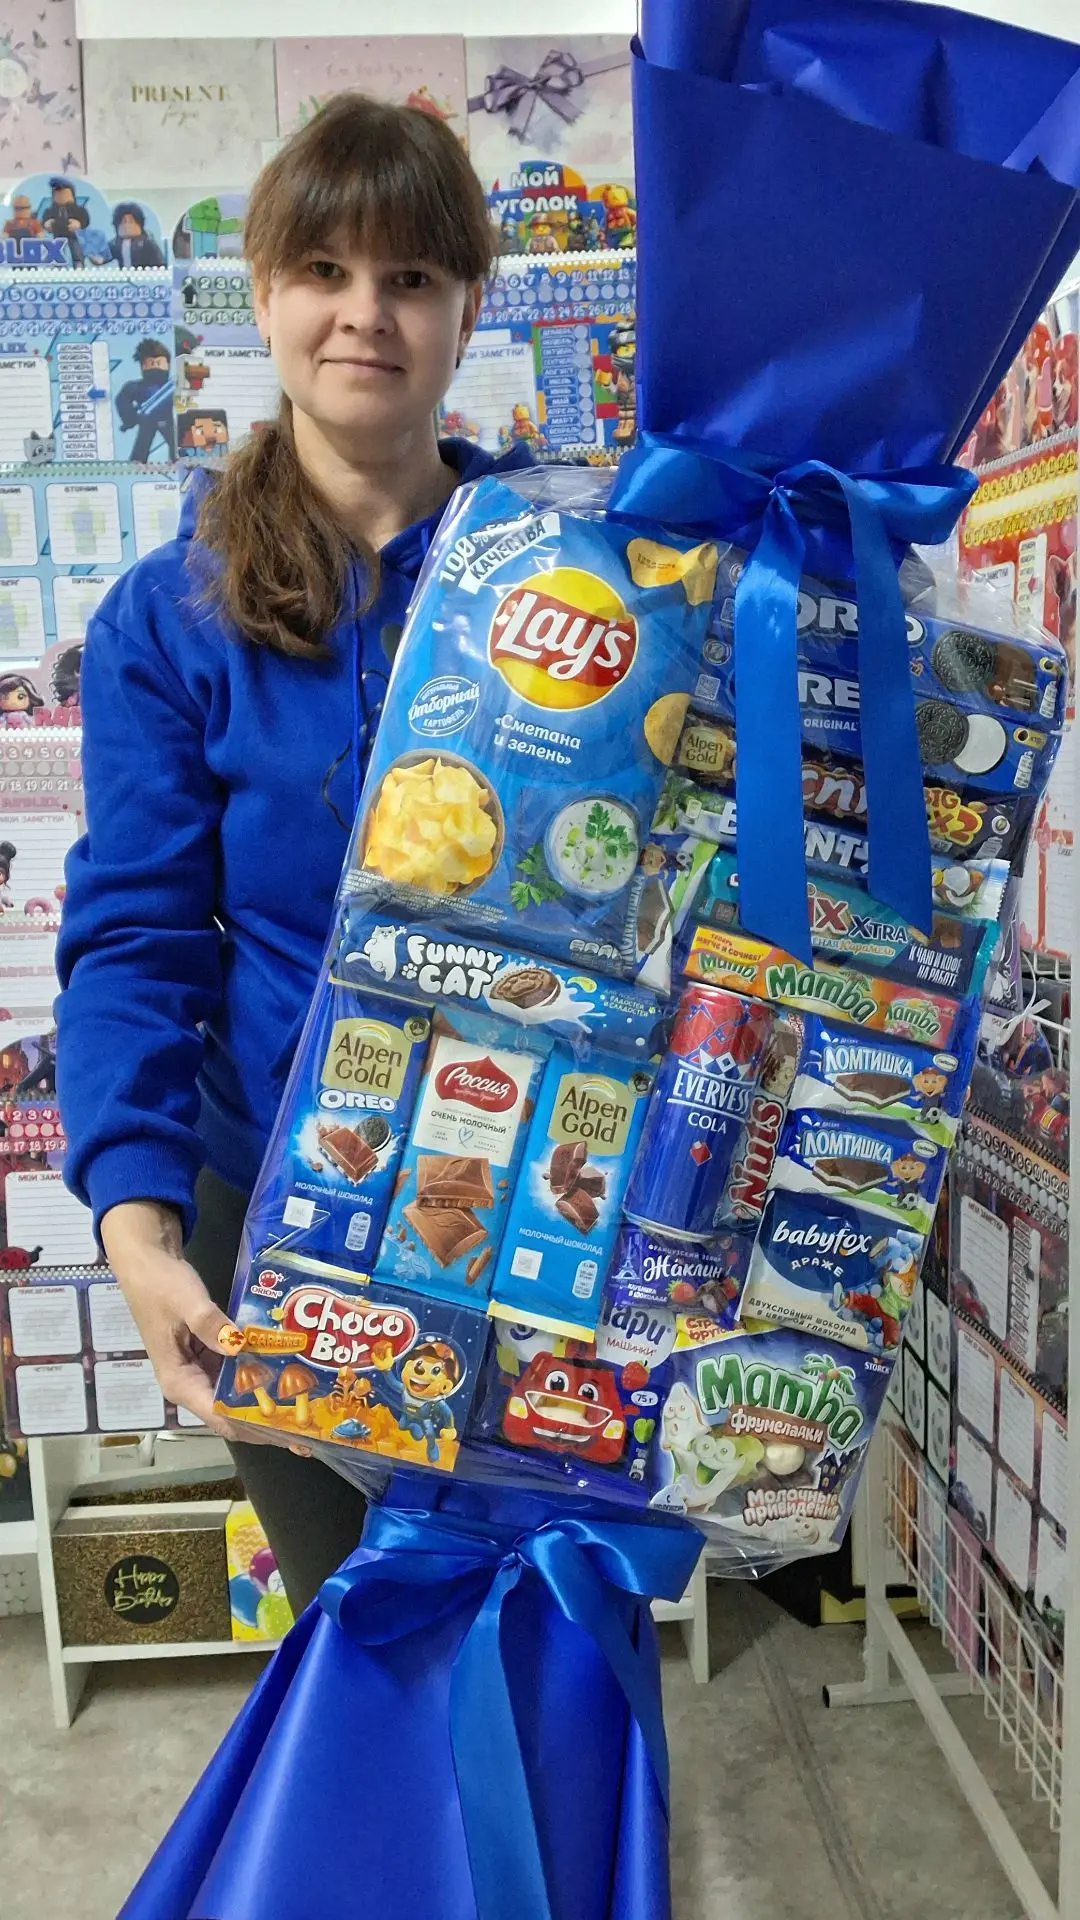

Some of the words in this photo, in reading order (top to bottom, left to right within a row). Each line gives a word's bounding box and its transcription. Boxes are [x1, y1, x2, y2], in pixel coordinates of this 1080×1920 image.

[132, 85, 225, 102] PRESENT
[511, 165, 559, 187] МОЙ
[496, 195, 577, 214] УГОЛОК
[201, 277, 211, 289] 2
[216, 277, 226, 289] 3
[232, 277, 242, 289] 4
[495, 276, 504, 287] 5
[510, 275, 519, 286] 6
[525, 274, 535, 286] 7
[557, 272, 566, 283] 9
[572, 271, 583, 282] 10
[588, 270, 598, 281] 11
[602, 269, 614, 280] 12
[618, 268, 629, 280] 13
[10, 289, 21, 300] 5
[26, 289, 36, 300] 6
[43, 288, 53, 299] 7
[58, 288, 68, 299] 8
[75, 288, 85, 299] 9
[90, 287, 102, 298] 10
[107, 287, 118, 298] 11
[122, 287, 133, 298] 12
[138, 287, 149, 298] 13
[153, 286, 166, 298] 14
[185, 311, 197, 324] 16
[201, 311, 214, 324] 17
[217, 311, 229, 324] 18
[233, 311, 244, 324] 19
[480, 348, 525, 359] ЗАМЕТКИ
[470, 518, 547, 580] КАЧЕСТВА
[495, 592, 630, 679] Lay's
[408, 681, 480, 720] Отборный
[423, 706, 465, 728] КАРТОФЕЛЬ
[804, 717, 857, 732] ORIGINAL
[494, 714, 582, 750] «Сметана
[687, 733, 723, 752] Alpen
[8, 747, 18, 759] 3
[24, 747, 33, 758] 4
[40, 747, 50, 758] 5
[55, 747, 65, 758] 6
[71, 747, 81, 757] 7
[494, 733, 505, 747] и
[508, 737, 572, 766] зелень»
[686, 748, 718, 765] Gold
[10, 781, 21, 791] 18
[26, 781, 37, 792] 19
[41, 781, 53, 791] 20
[57, 781, 68, 791] 21
[850, 915, 909, 944] XTRA
[406, 935, 502, 972] FUNNY
[908, 945, 916, 961] К
[916, 947, 932, 967] ЧАЮ
[933, 951, 941, 967] И
[941, 954, 963, 973] КОФЕ
[418, 963, 492, 999] CAT
[916, 964, 928, 979] НА
[928, 966, 959, 987] РАБОТЕ
[766, 964, 877, 1023] Mamba
[334, 1032, 402, 1067] Alpen
[335, 1058, 392, 1089] Gold
[825, 1047, 914, 1078] ЛОМТИШКА
[444, 1066, 510, 1100] Россия
[673, 1068, 752, 1114] EVERVESS
[320, 1090, 396, 1112] OREO
[560, 1089, 628, 1122] Alpen
[12, 1110, 23, 1121] 2
[28, 1110, 37, 1120] 3
[42, 1109, 52, 1119] 4
[431, 1110, 457, 1122] ОЧЕНЬ
[460, 1116, 507, 1134] МОЛОЧНЫЙ
[687, 1112, 728, 1134] COLA
[561, 1112, 617, 1143] Gold
[14, 1141, 25, 1151] 17
[30, 1141, 41, 1151] 18
[45, 1140, 56, 1151] 19
[805, 1131, 893, 1163] ЛОМТИШКА
[295, 1181, 336, 1196] МОЛОЧНЫЙ
[337, 1190, 373, 1205] ШОКОЛАД
[519, 1227, 564, 1244] МОЛОЧНЫЙ
[564, 1239, 603, 1256] ШОКОЛАД
[772, 1220, 872, 1256] babyfox
[791, 1257, 844, 1278] ДРАЖЕ
[251, 1286, 280, 1299] ORION
[294, 1294, 405, 1337] Choco
[748, 1297, 813, 1320] ДВУХСЛОЙНЫЙ
[815, 1317, 857, 1336] ШОКОЛАД
[806, 1323, 844, 1339] ГЛАЗУРИ
[310, 1332, 372, 1364] Boy
[864, 1361, 891, 1375] STORCK
[637, 1394, 648, 1403] 75
[697, 1354, 863, 1449] Mamba
[747, 1489, 840, 1507] Молочные
[744, 1501, 840, 1527] привидения
